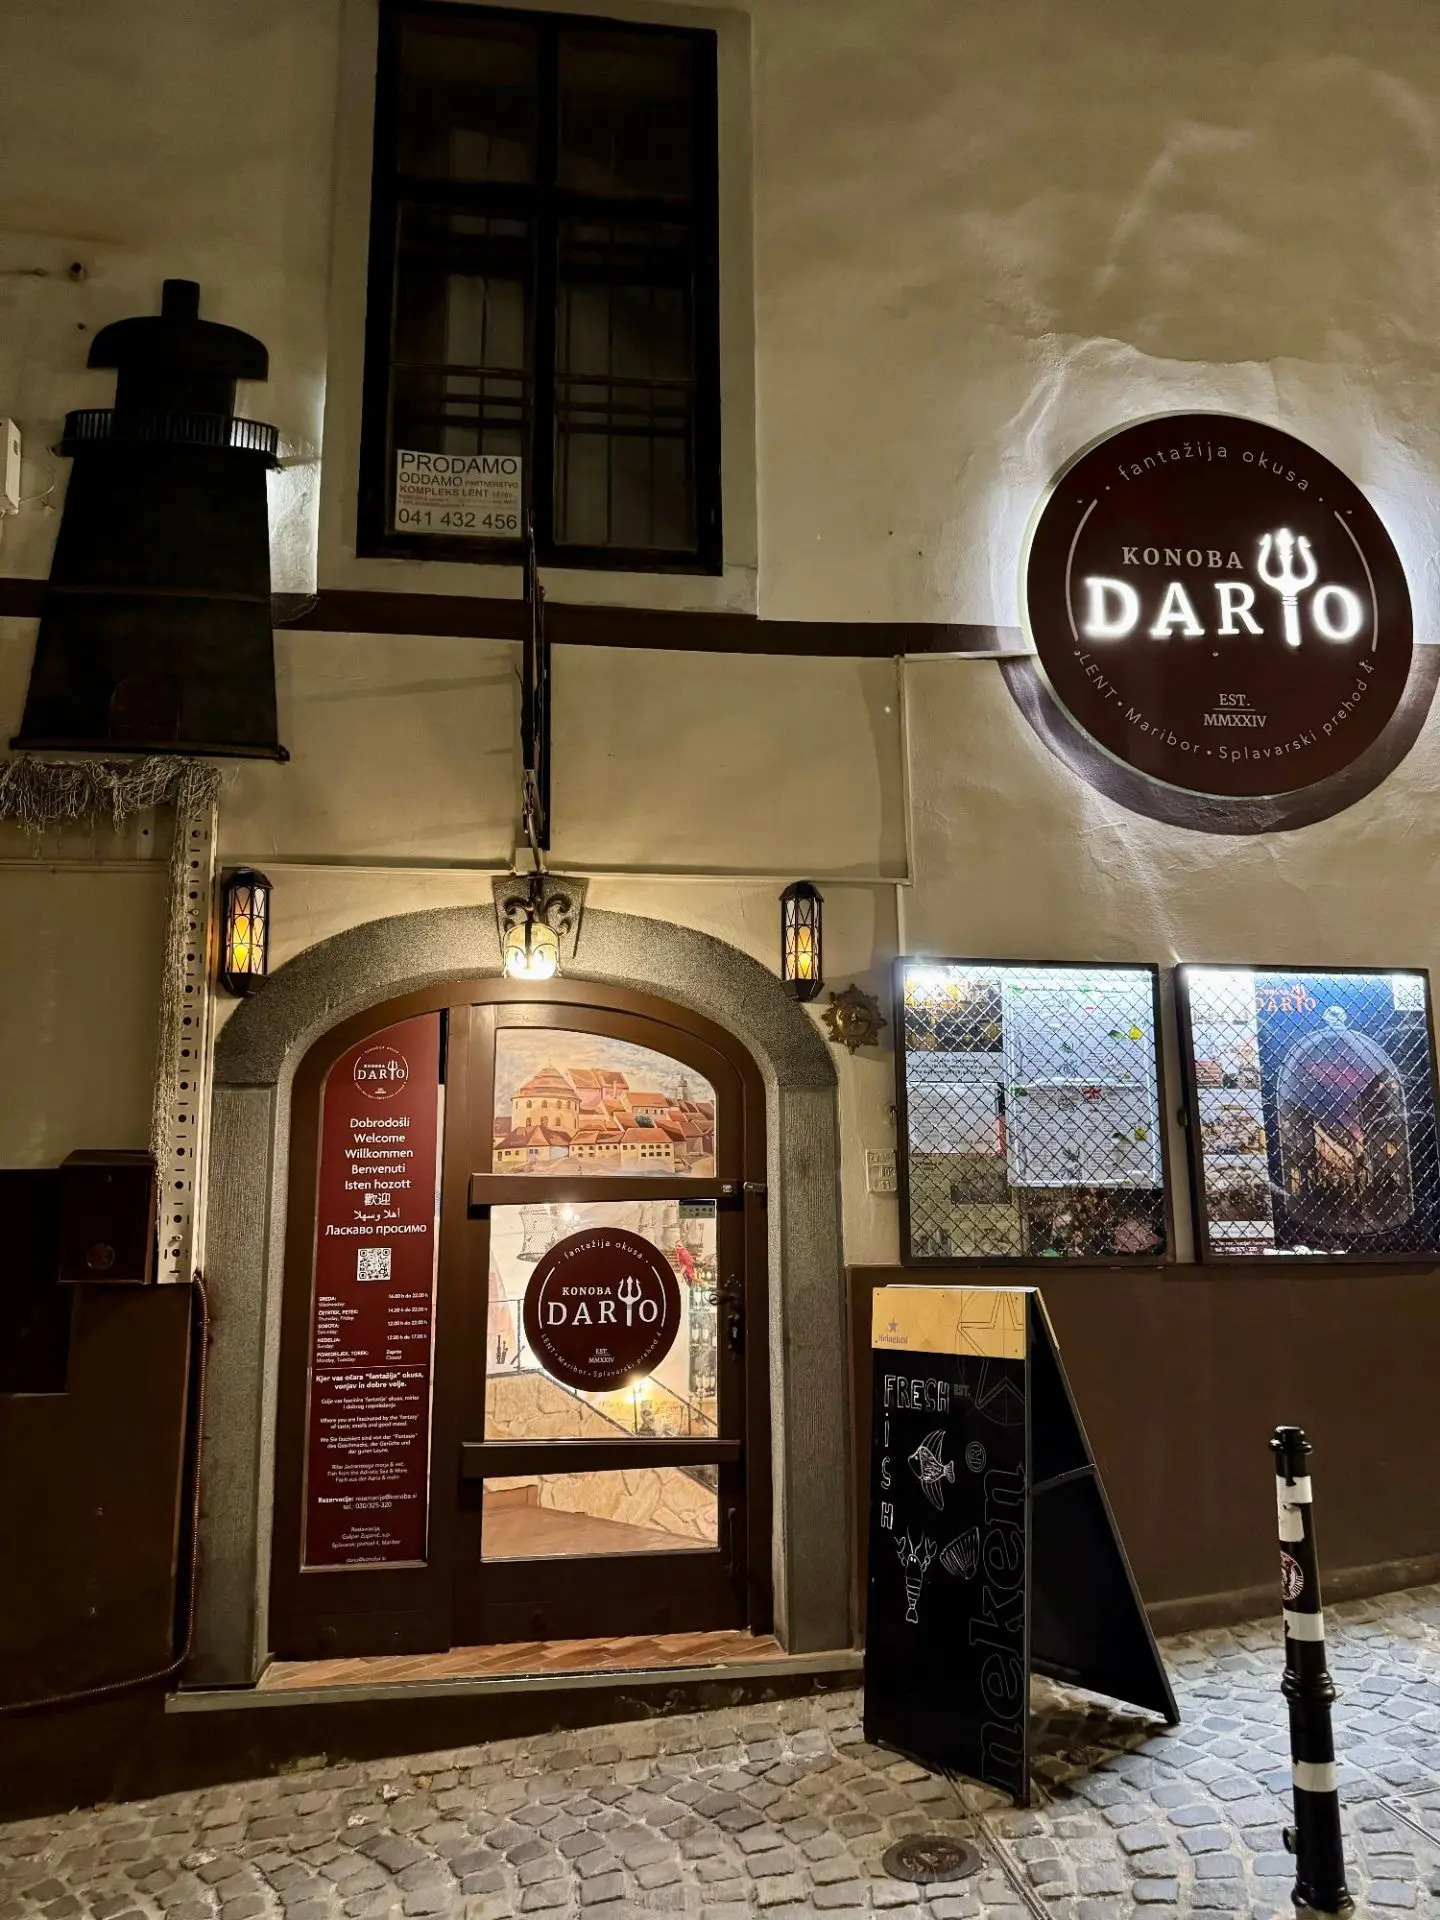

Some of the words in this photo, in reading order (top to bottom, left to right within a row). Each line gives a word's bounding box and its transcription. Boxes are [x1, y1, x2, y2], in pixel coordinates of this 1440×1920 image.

[400, 452, 518, 475] PRODAMO
[1118, 441, 1228, 481] fantažija
[1242, 451, 1309, 492] okusa
[399, 471, 463, 487] ODDAMO
[399, 485, 460, 497] KOMPLEKS
[462, 488, 489, 498] LENT
[398, 508, 432, 526] 041
[440, 511, 476, 528] 432
[482, 514, 517, 530] 456
[1122, 547, 1244, 570] KONOBA
[1082, 528, 1364, 648] DARIO
[1219, 694, 1251, 706] EST.
[1080, 654, 1118, 698] LENT
[1125, 706, 1200, 753] Maribor
[1219, 729, 1317, 762] Splavarski
[1322, 678, 1367, 736] prehod
[1203, 713, 1267, 728] MMXXIV
[349, 1117, 410, 1128] Dobrodošli
[354, 1133, 406, 1143] Welcome
[345, 1148, 414, 1159] Willkommen
[351, 1163, 406, 1174] Benvenuti
[345, 1180, 371, 1190] Isten
[374, 1179, 411, 1189] hozott
[325, 1225, 373, 1236] Ласкаво
[376, 1225, 427, 1236] просимо
[615, 1241, 643, 1259] okusa
[562, 1286, 612, 1297] KONOBA
[547, 1276, 659, 1327] DARIO
[316, 1375, 330, 1383] Kjer
[334, 1383, 357, 1391] vonjav
[884, 1374, 950, 1413] FRESH
